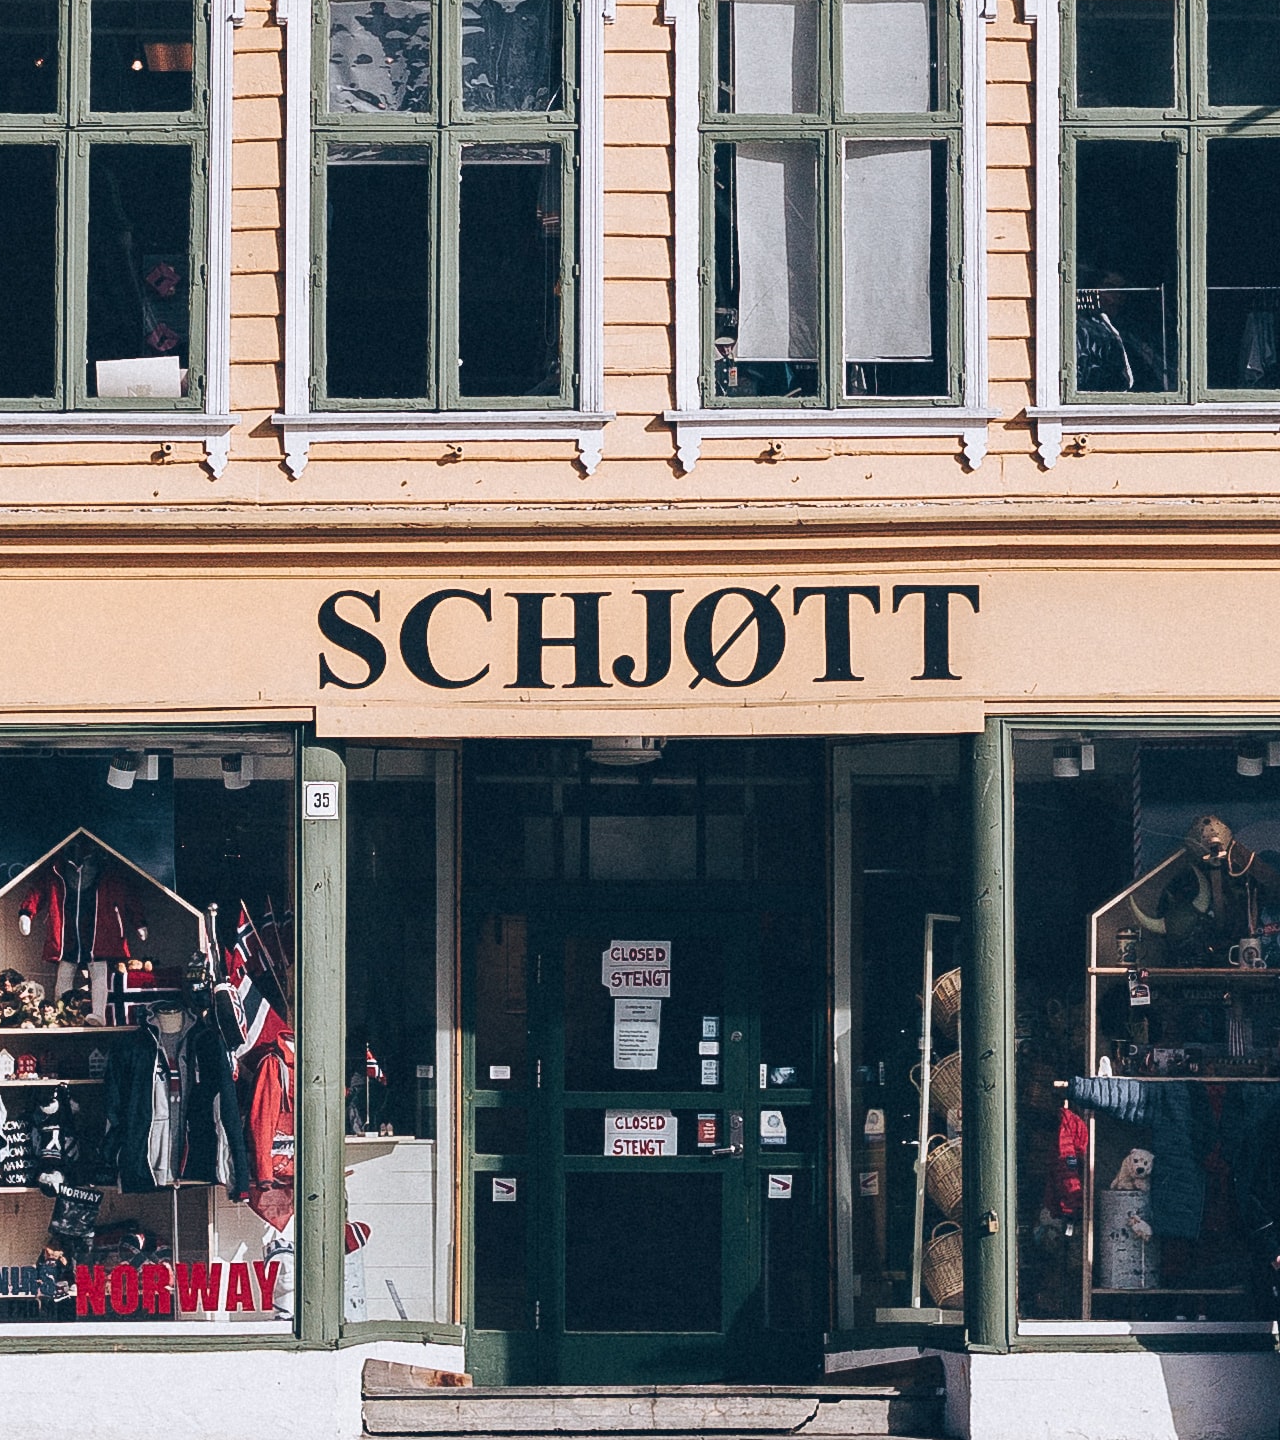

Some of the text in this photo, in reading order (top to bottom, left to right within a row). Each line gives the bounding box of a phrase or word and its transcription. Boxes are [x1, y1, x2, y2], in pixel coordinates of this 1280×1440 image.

[317, 584, 981, 690] SCHJØTT
[313, 792, 330, 808] 35
[610, 947, 666, 962] CLOSED
[610, 969, 671, 987] STENGT
[614, 1115, 666, 1130] CLOSED
[612, 1138, 666, 1156] STENGT
[60, 1185, 101, 1203] NORWAY
[75, 1261, 281, 1316] NORWAY
